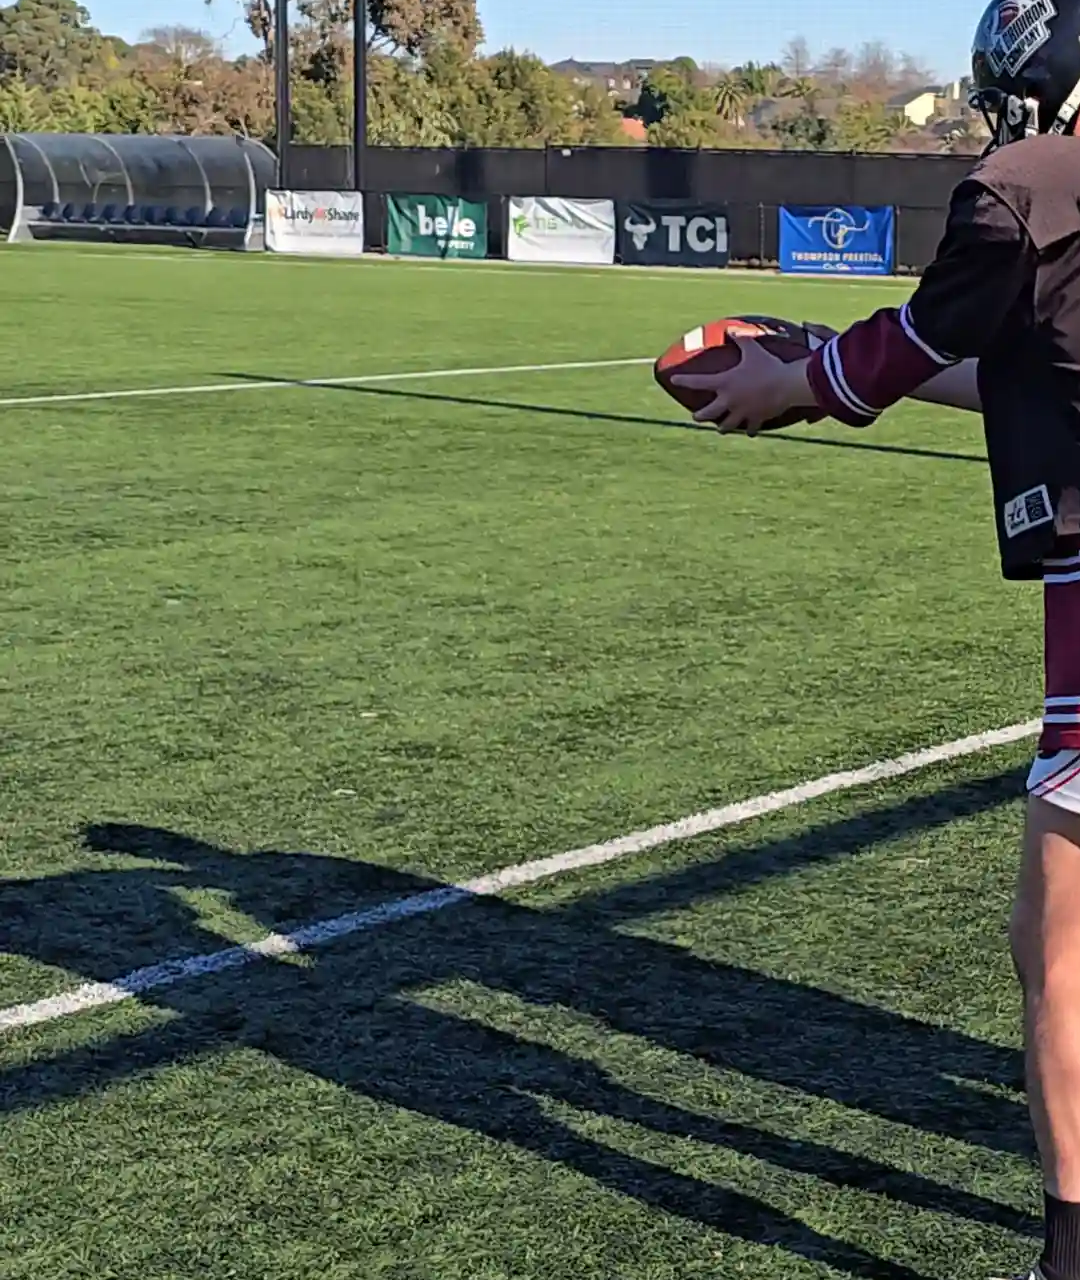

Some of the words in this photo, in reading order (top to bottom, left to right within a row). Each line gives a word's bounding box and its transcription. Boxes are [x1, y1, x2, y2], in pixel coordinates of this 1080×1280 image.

[416, 204, 477, 238] belle
[661, 215, 728, 253] TCI
[791, 251, 841, 262] THOMPSON
